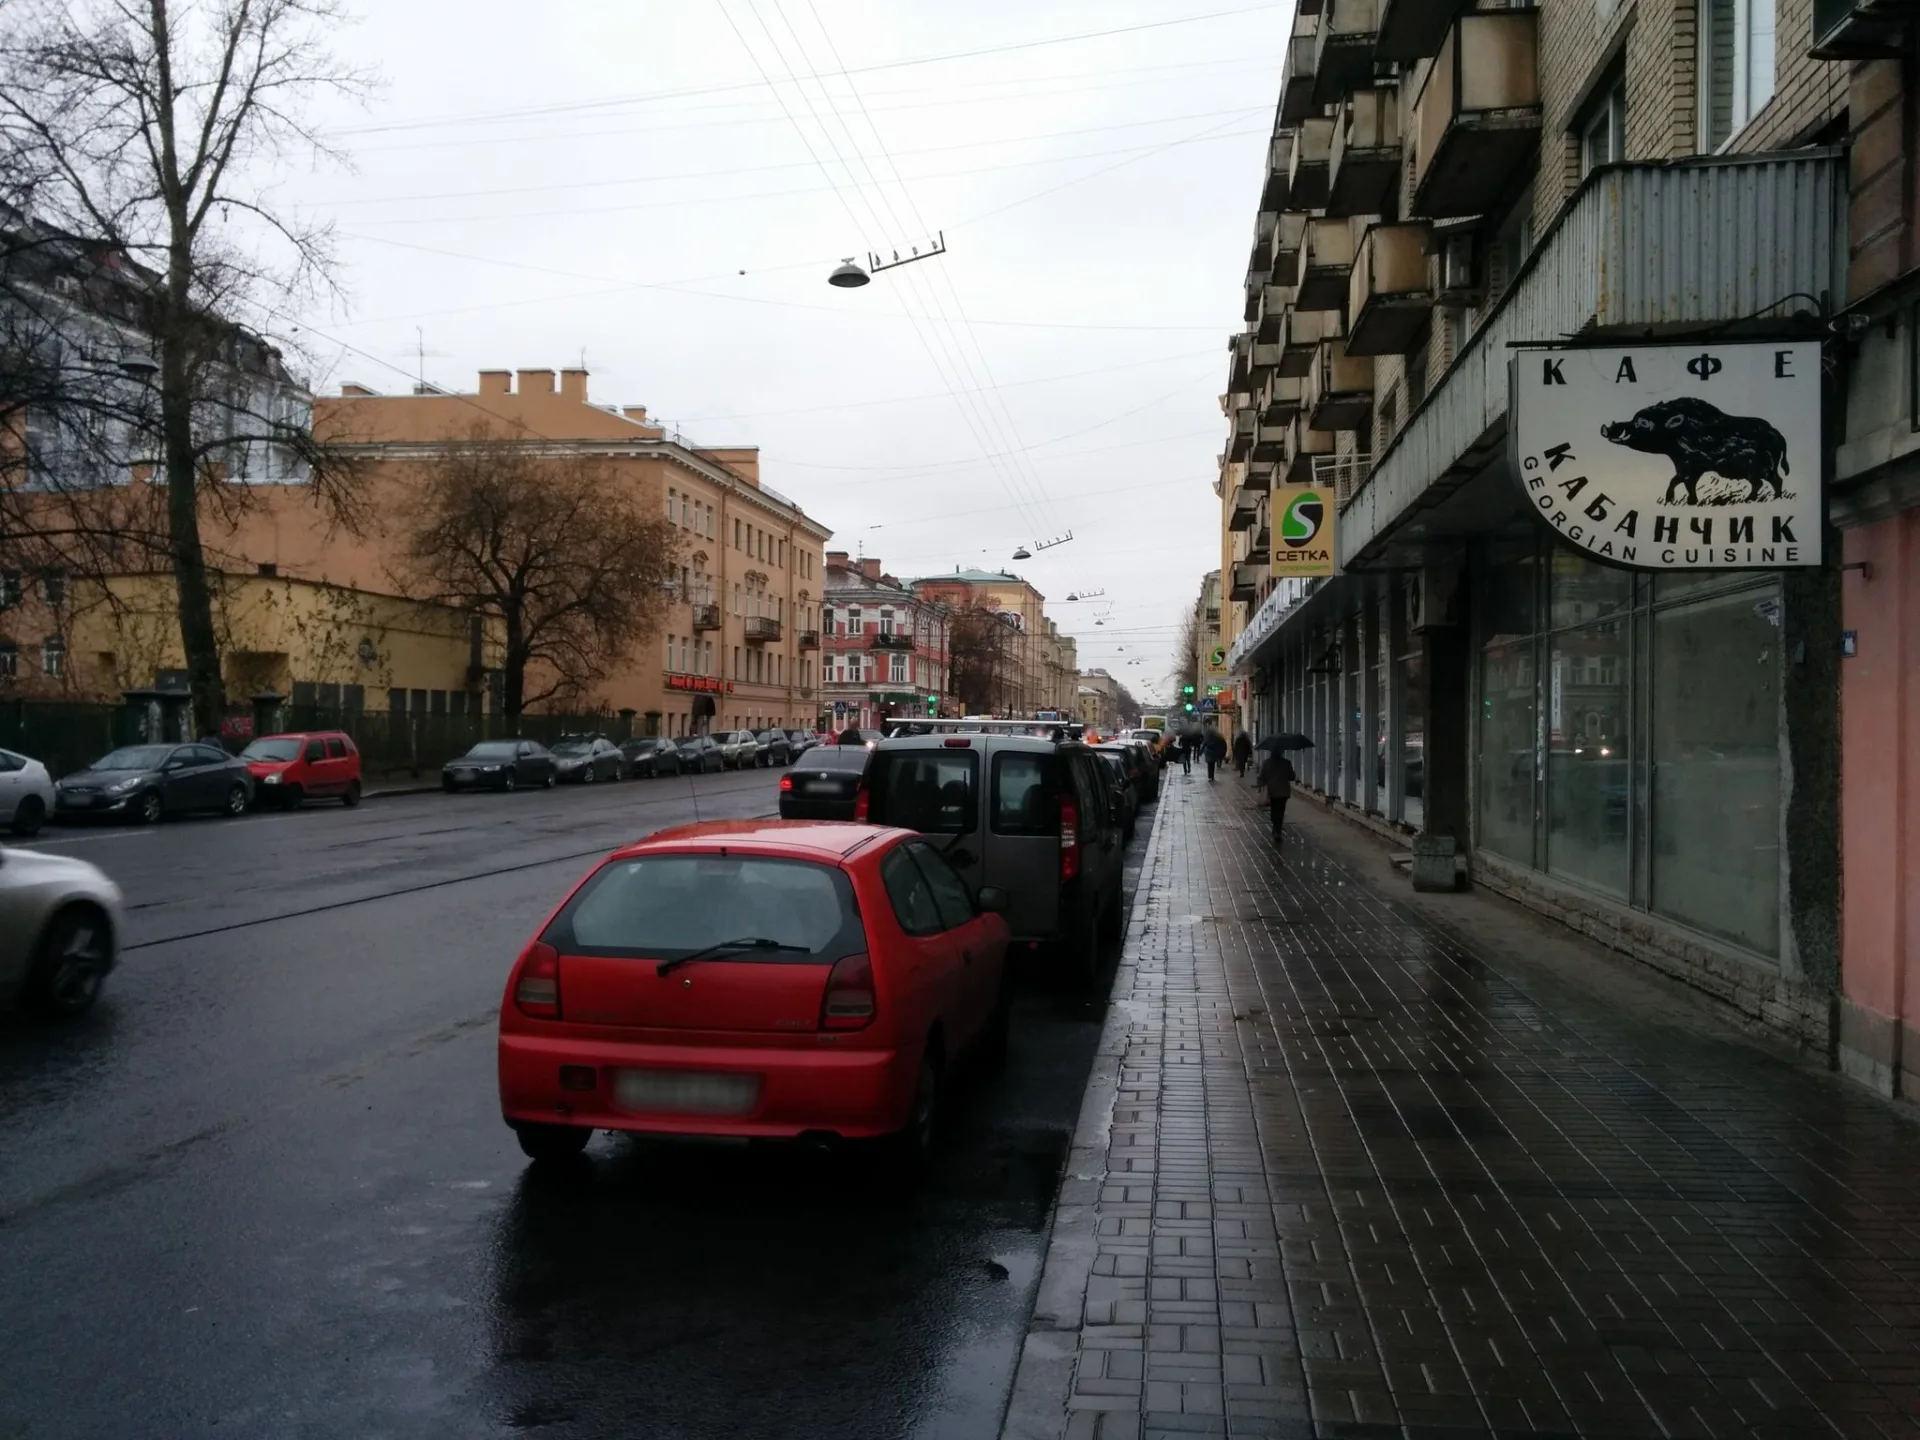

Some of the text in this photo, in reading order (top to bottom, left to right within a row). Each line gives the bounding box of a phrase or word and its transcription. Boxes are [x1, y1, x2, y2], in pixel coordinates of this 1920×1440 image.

[1542, 350, 1796, 386] КАФЕ
[1523, 456, 1799, 564] GEORGIAN CUISINE
[1543, 442, 1798, 546] КАБАНЧИК
[1275, 549, 1329, 562] СЕТКА
